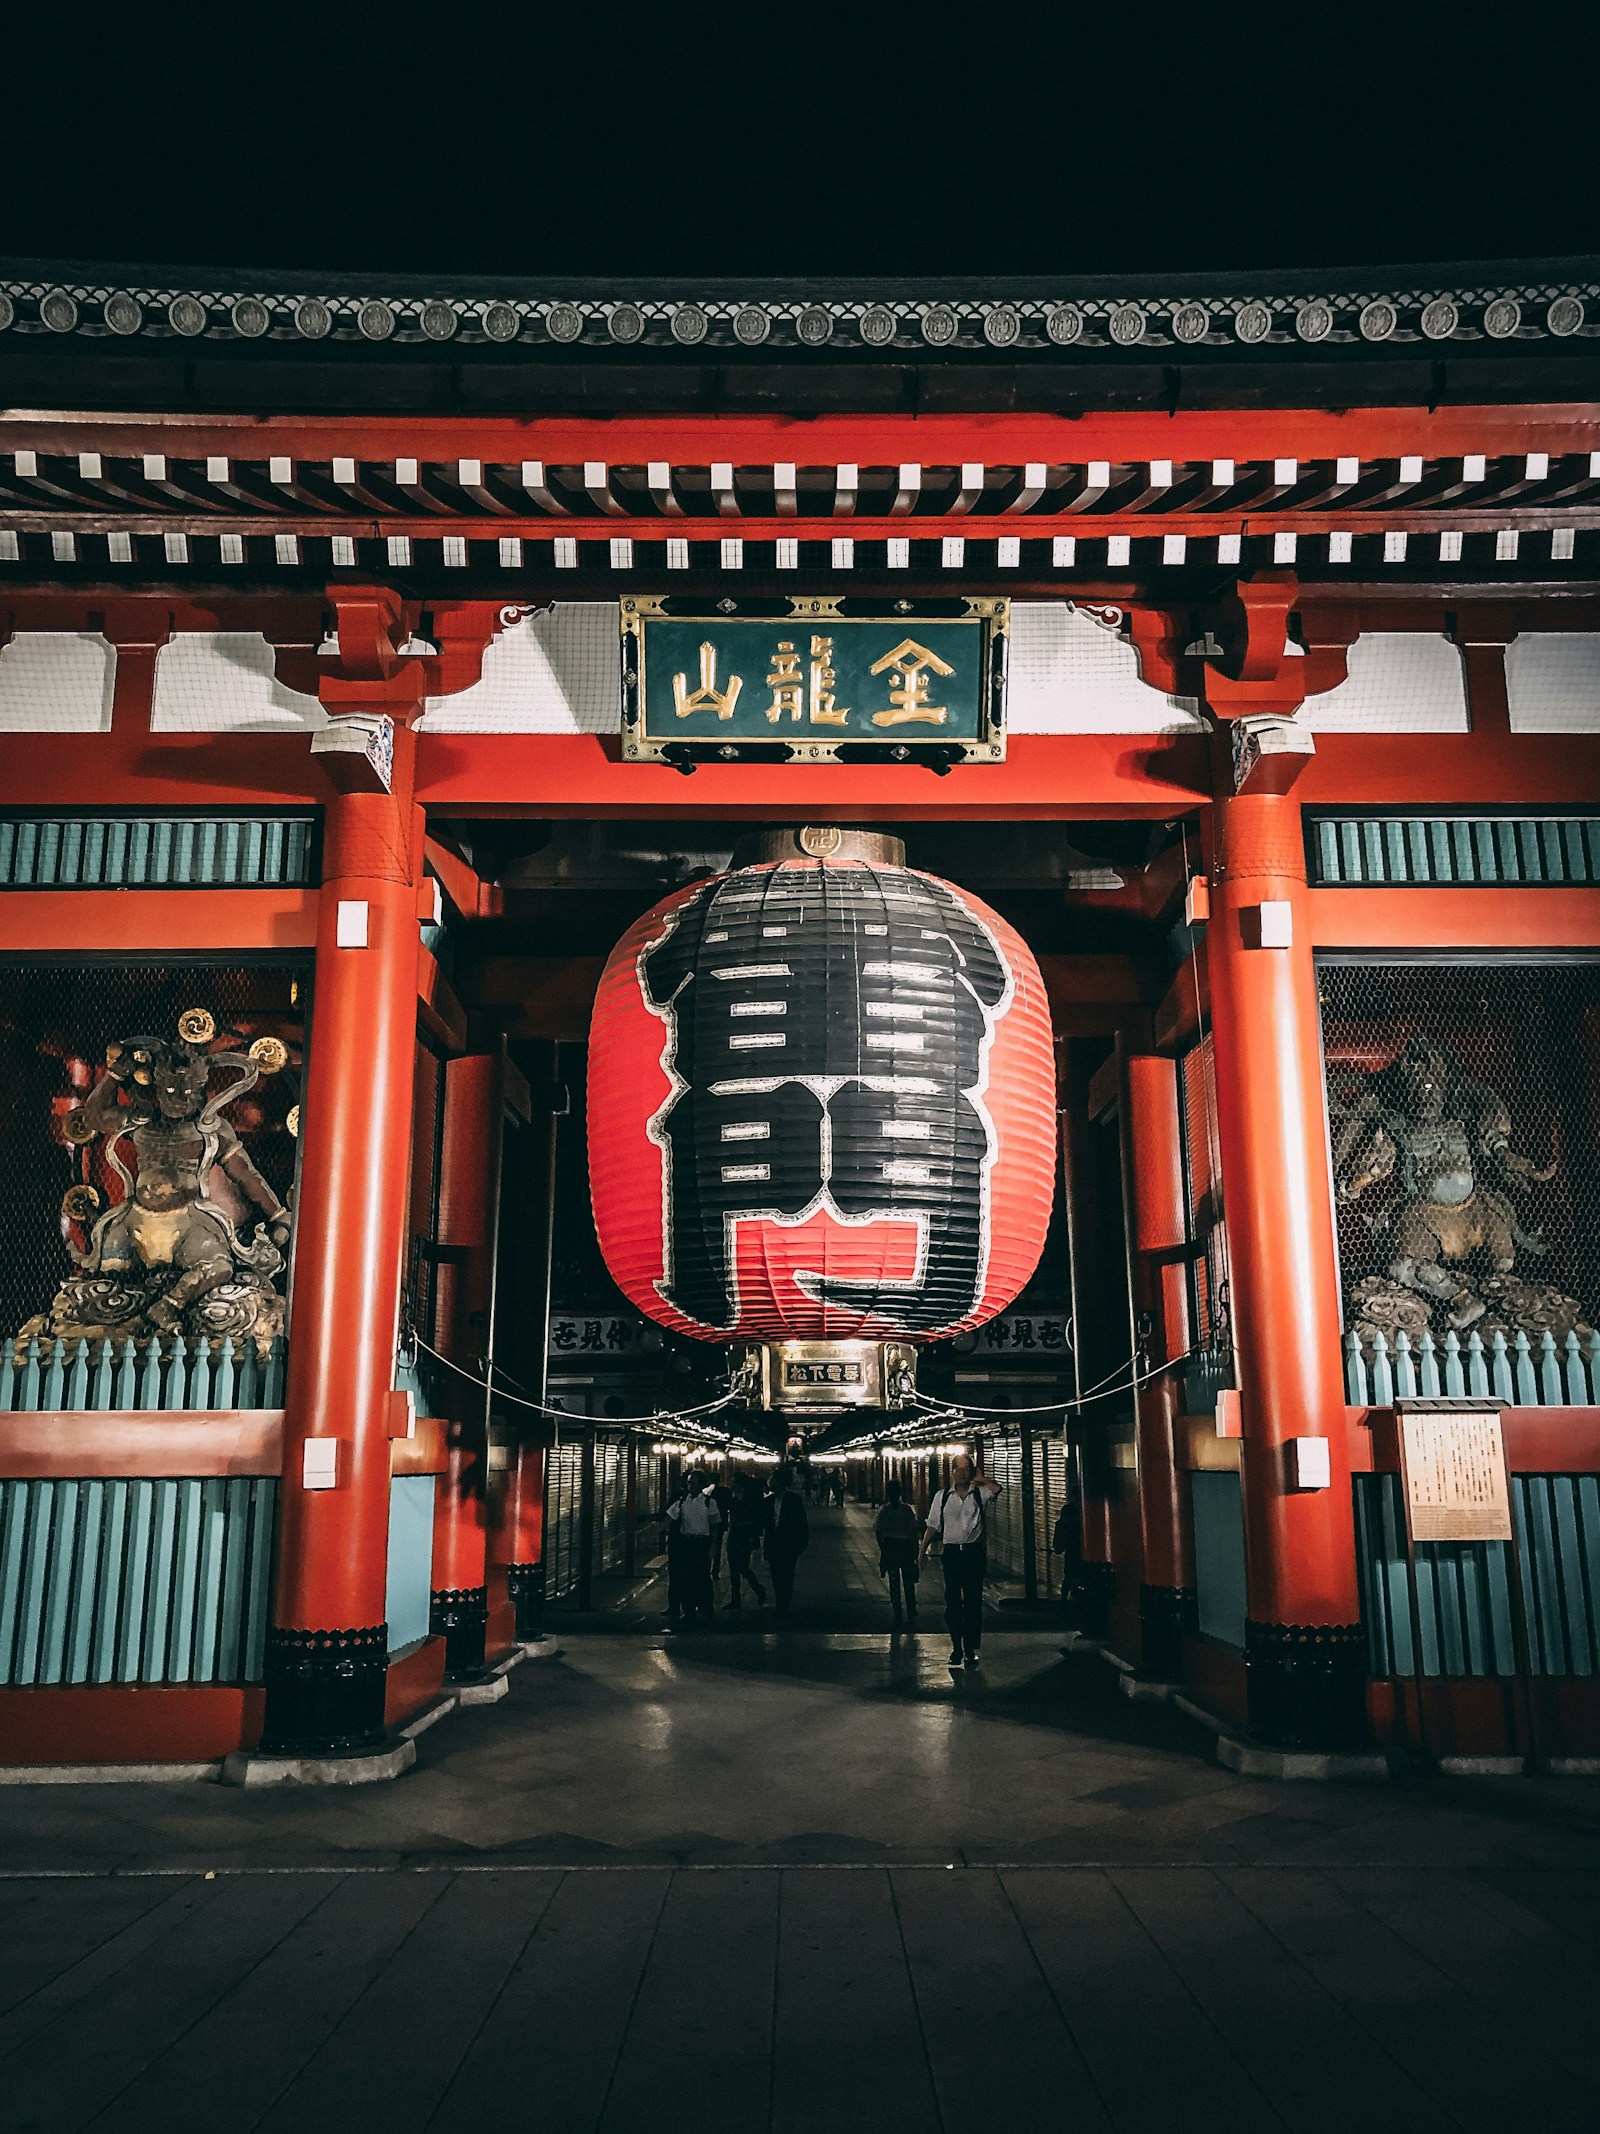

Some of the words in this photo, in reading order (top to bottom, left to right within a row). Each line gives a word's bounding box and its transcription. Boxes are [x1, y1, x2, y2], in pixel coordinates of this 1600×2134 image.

[672, 634, 956, 727] 金龍山
[636, 863, 1014, 1332] 雷門
[790, 1364, 859, 1381] 松下電器
